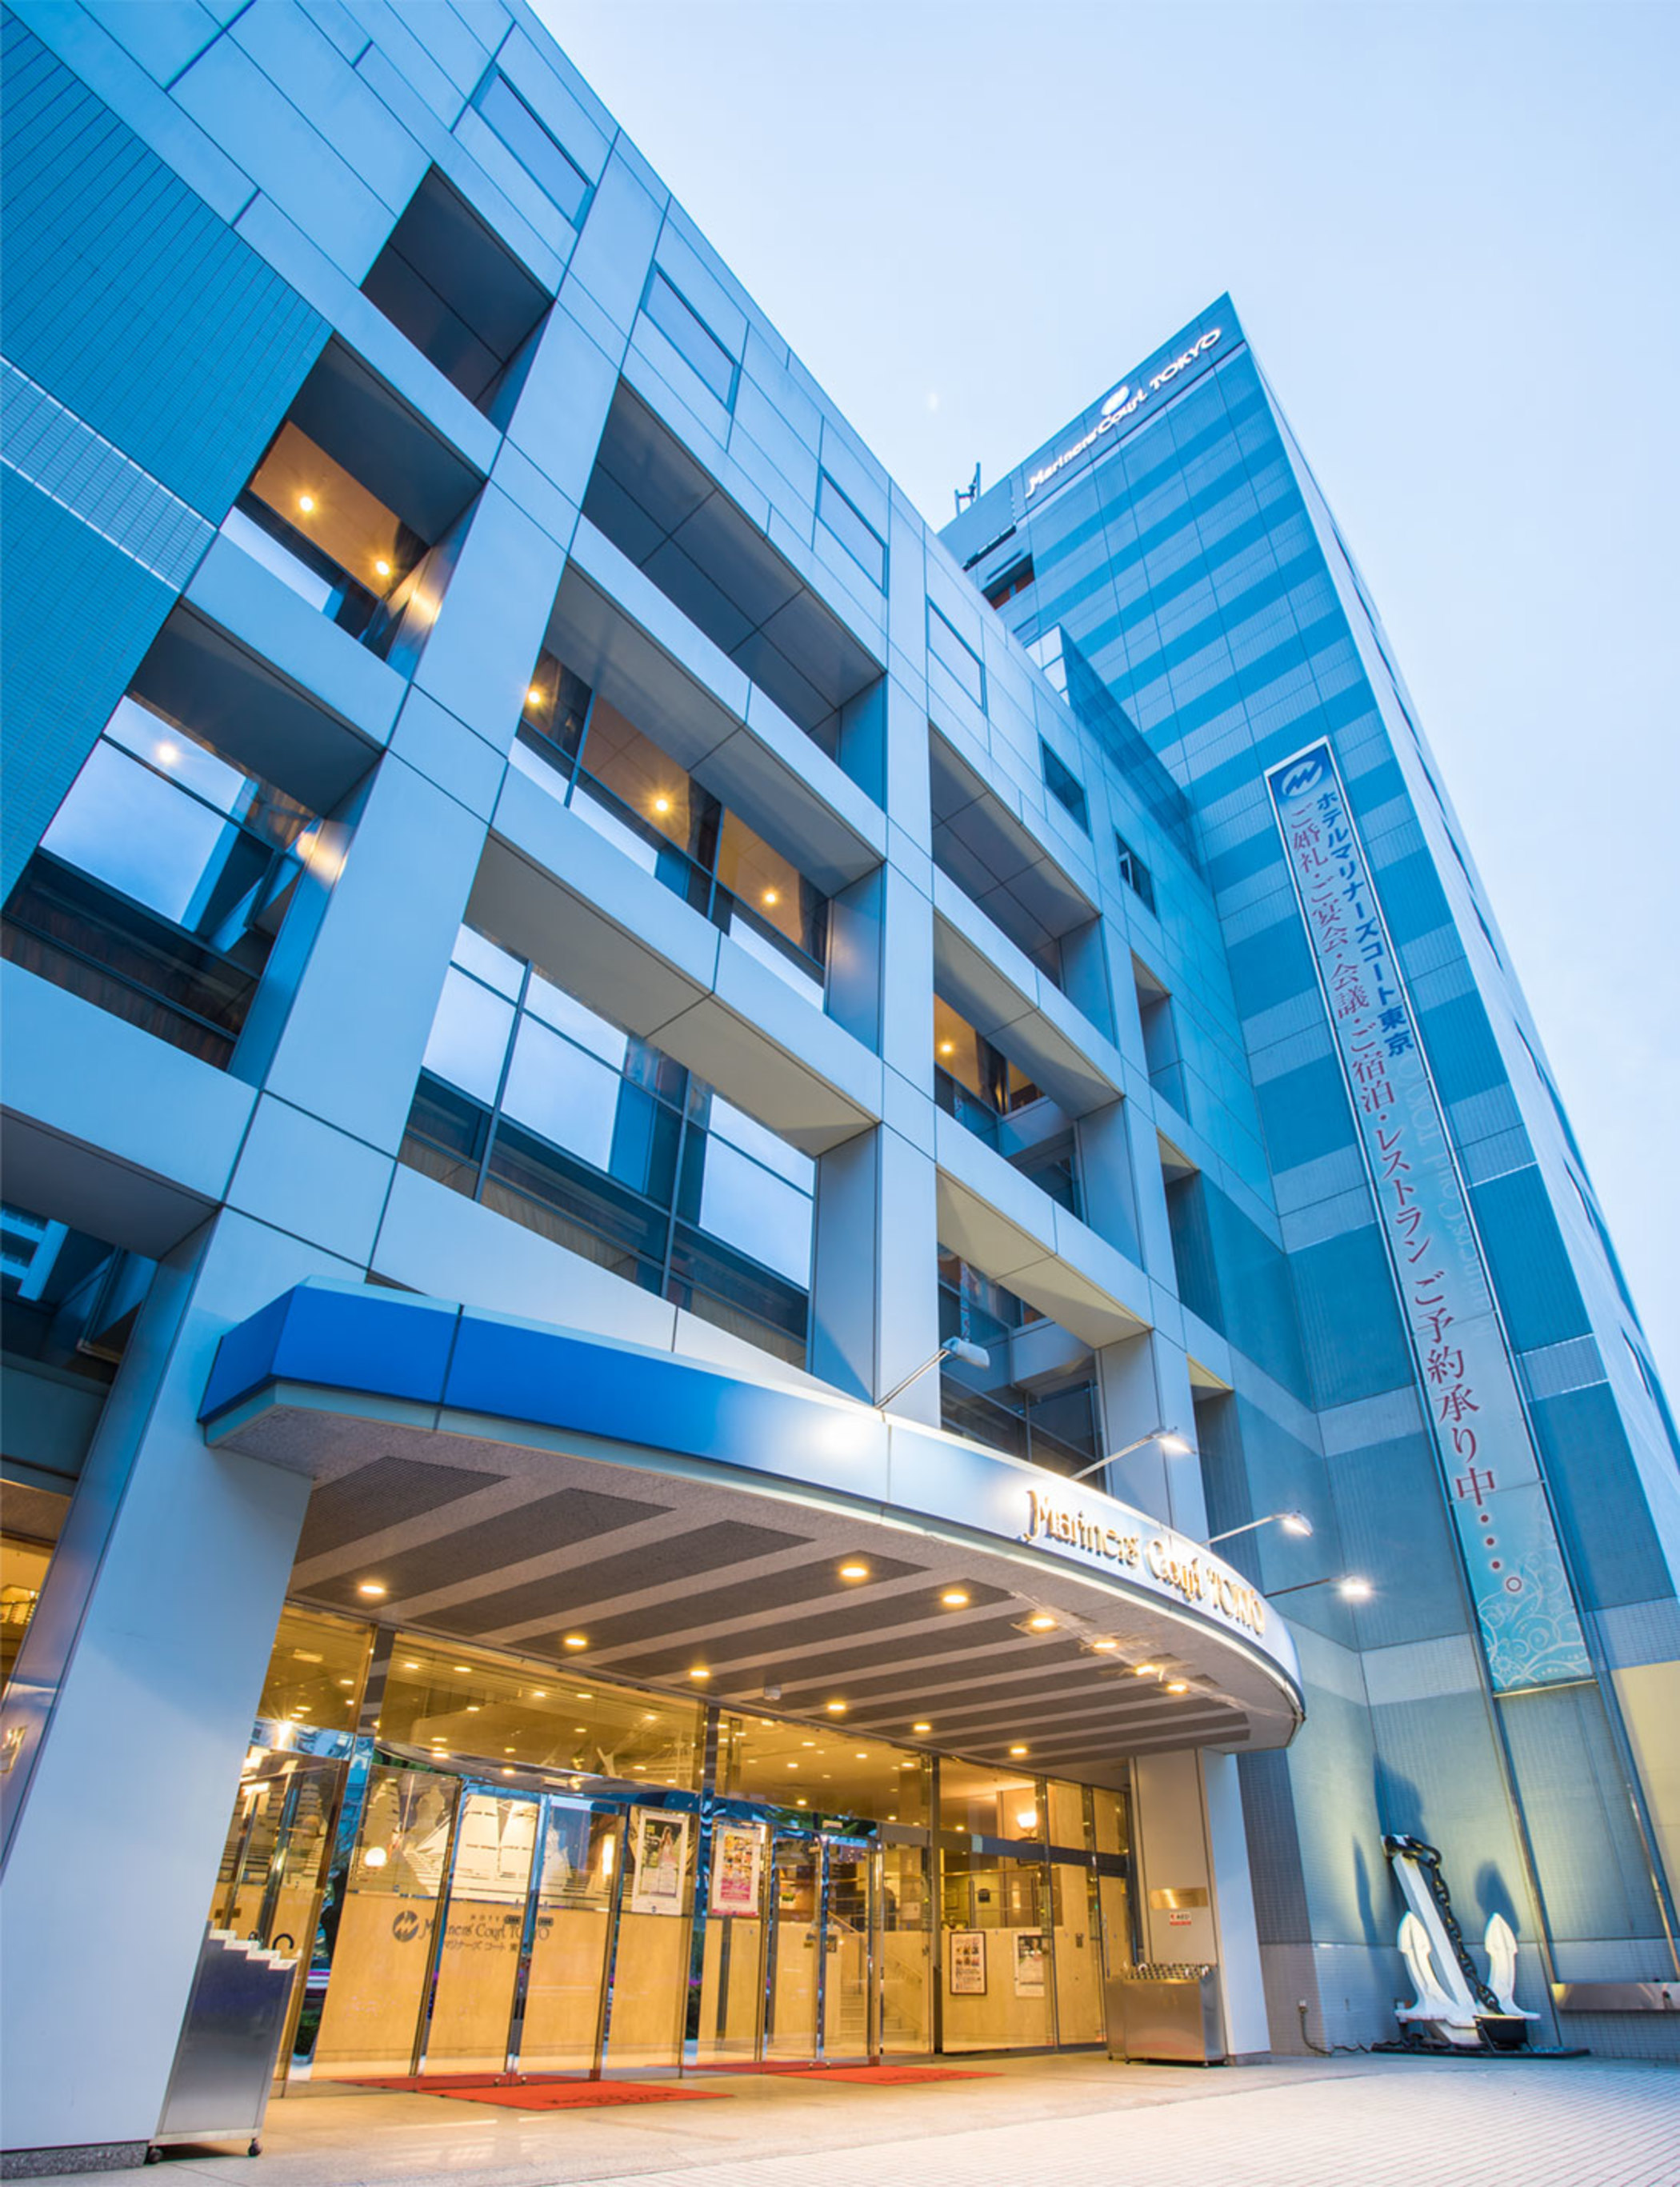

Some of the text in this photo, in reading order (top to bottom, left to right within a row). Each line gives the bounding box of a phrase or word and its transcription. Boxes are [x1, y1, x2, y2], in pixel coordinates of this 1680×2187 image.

[1150, 328, 1221, 390] TOKYO
[1317, 790, 1414, 1058] ホテルマリナーズコート東京
[1146, 1540, 1206, 1602] Court
[1206, 1566, 1265, 1636] TOKYO
